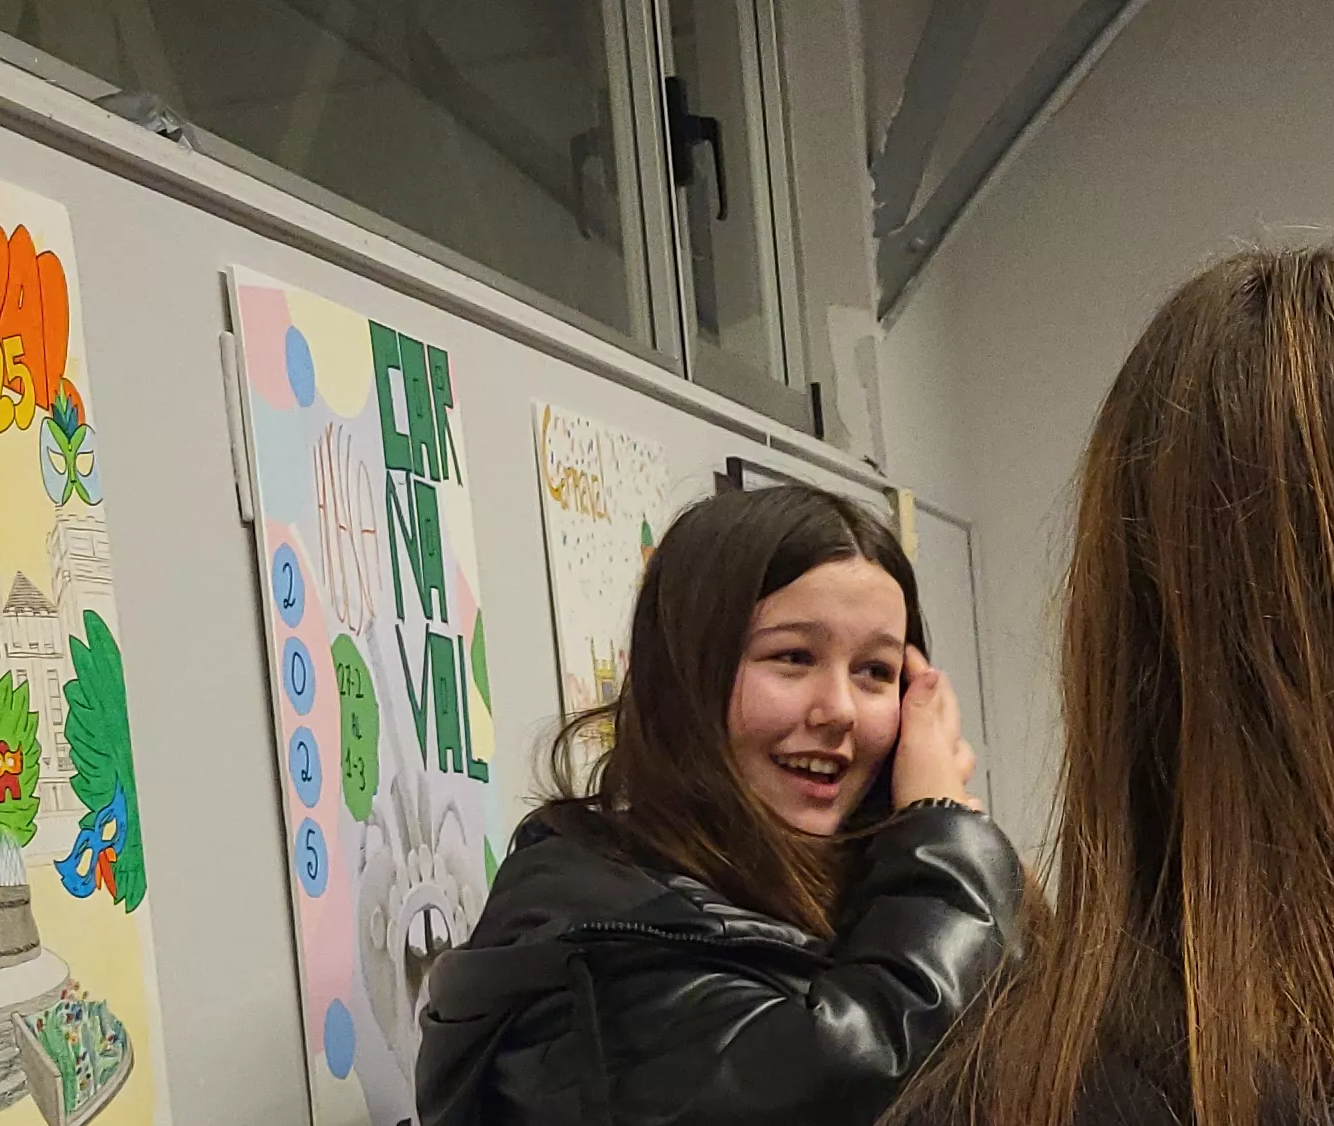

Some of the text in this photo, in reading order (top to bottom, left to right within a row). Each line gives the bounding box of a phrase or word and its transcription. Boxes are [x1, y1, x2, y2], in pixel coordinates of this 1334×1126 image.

[367, 318, 464, 488] CAR
[385, 469, 449, 625] NA
[395, 622, 490, 783] VAL
